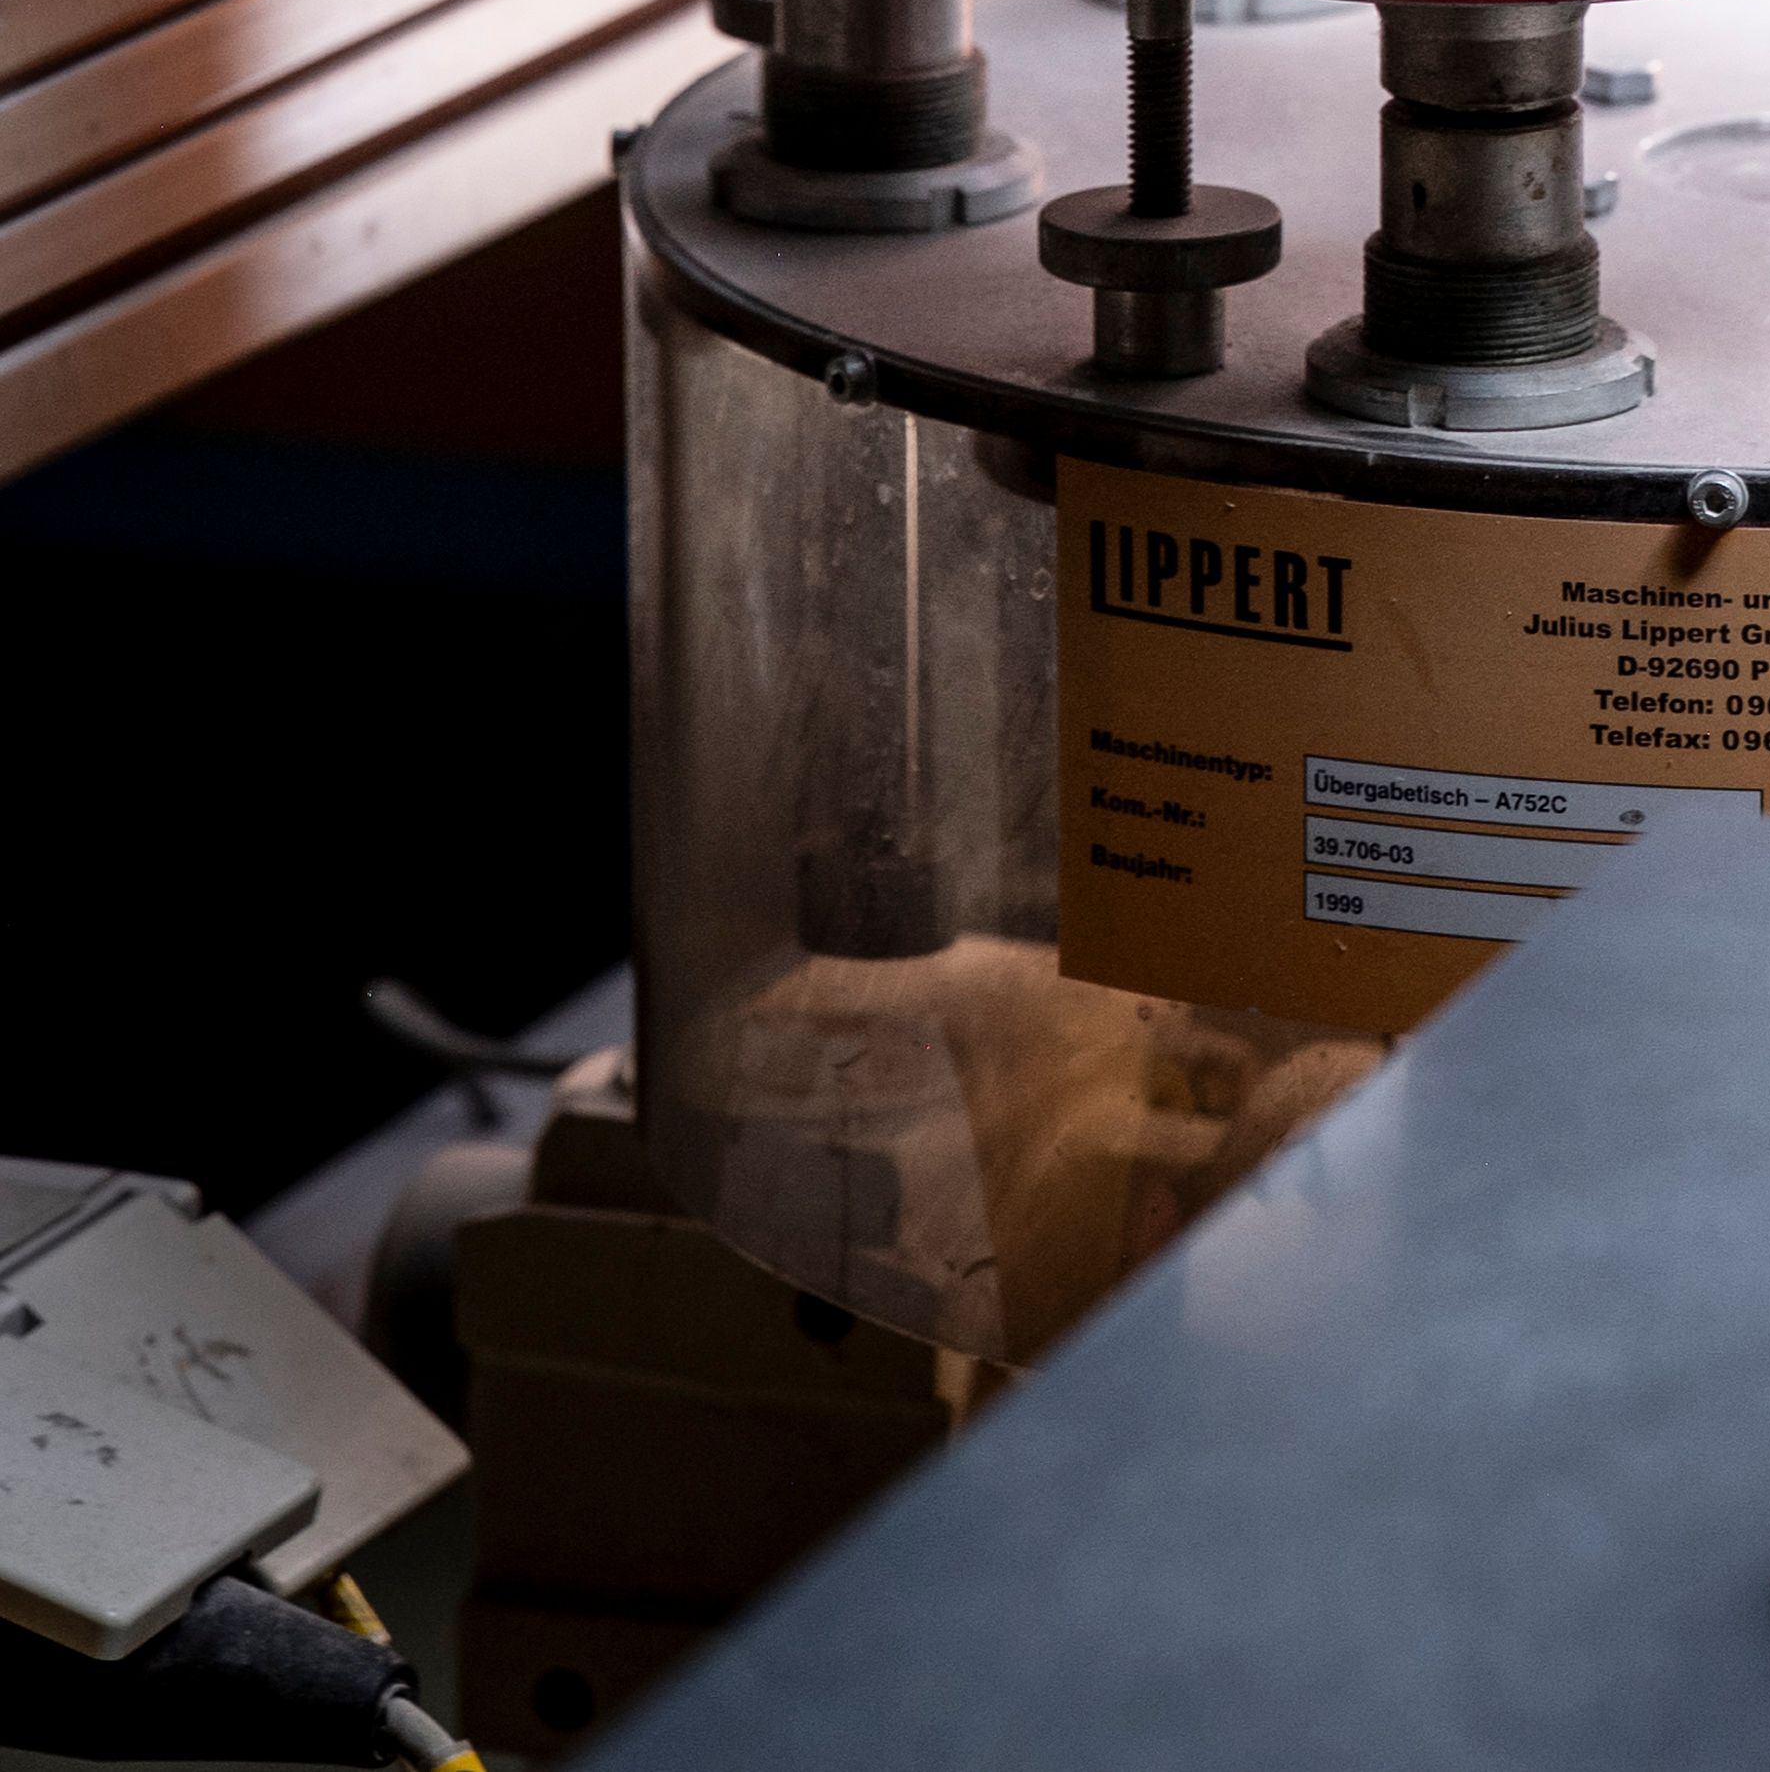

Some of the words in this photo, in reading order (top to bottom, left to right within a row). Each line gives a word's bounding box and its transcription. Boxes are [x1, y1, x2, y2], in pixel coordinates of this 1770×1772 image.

[1089, 519, 1353, 652] LIPPERT
[1561, 581, 1733, 608] Maschinen-
[1523, 613, 1612, 640] Julius
[1621, 619, 1731, 647] Lippert
[1616, 655, 1740, 680] D-92690
[1593, 688, 1714, 715] Telefon:
[1589, 723, 1711, 750] Telefax:
[1091, 729, 1272, 783] Maschinentyp:
[1313, 768, 1469, 807] Übergabetisch
[1494, 792, 1568, 815] A752C
[1091, 786, 1206, 828] Kom.-Nr.:
[1313, 835, 1414, 865] 39.706-03
[1091, 843, 1193, 885] Baujahr:
[1314, 892, 1364, 916] 1999
